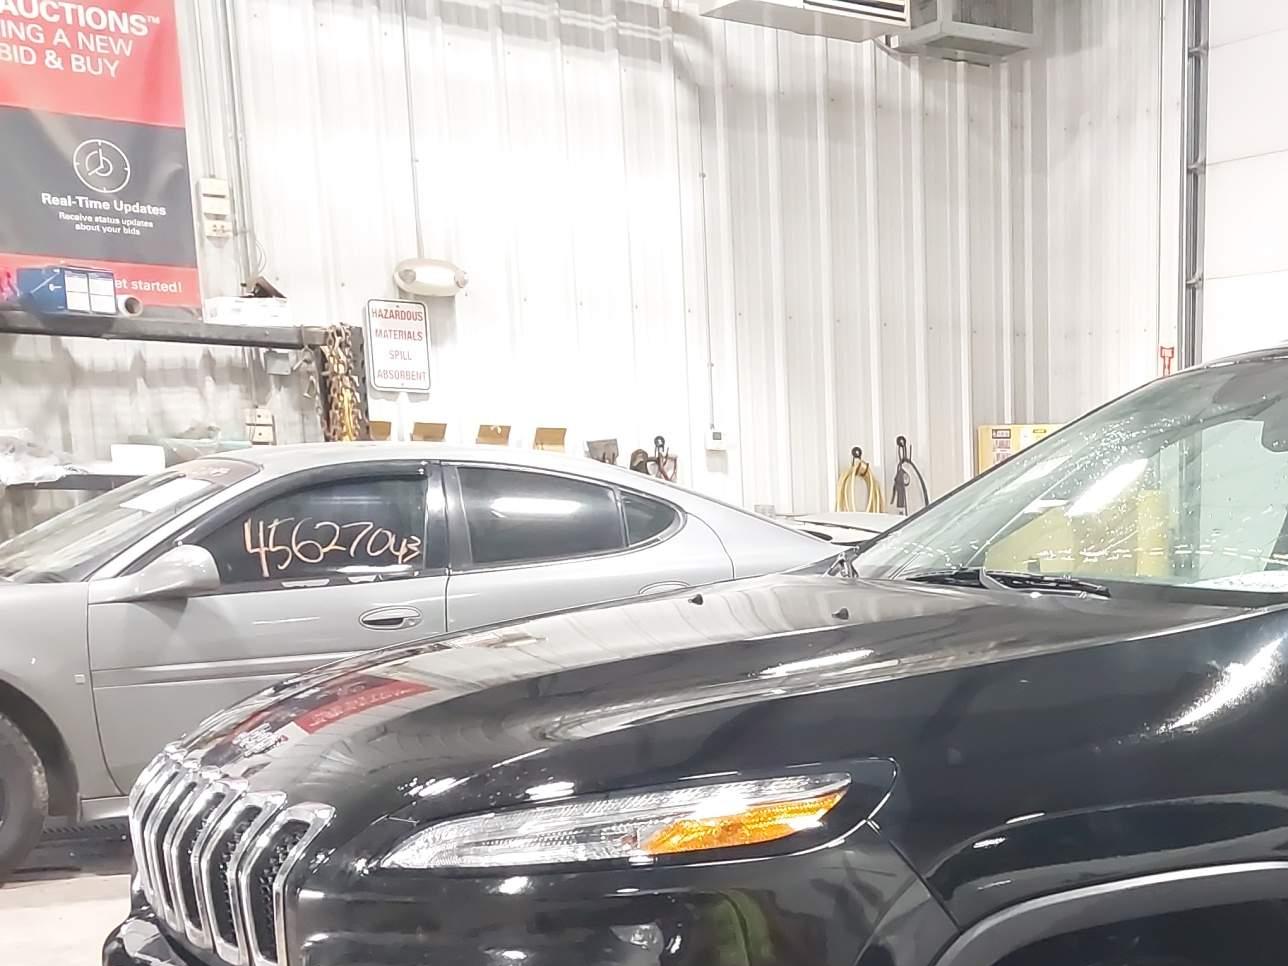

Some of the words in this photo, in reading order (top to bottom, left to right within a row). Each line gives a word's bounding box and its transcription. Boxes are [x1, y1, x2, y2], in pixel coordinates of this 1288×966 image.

[53, 28, 71, 48] A
[77, 31, 133, 56] NEW
[0, 42, 37, 65] BID
[44, 48, 64, 70] &
[70, 53, 120, 78] BUY
[41, 192, 110, 210] Real-Time
[113, 199, 167, 216] Updates
[58, 211, 93, 222] Receive
[94, 214, 120, 225] status
[121, 217, 154, 228] updates
[74, 222, 101, 232] about
[101, 225, 121, 234] your
[122, 225, 141, 235] bids
[114, 278, 129, 289] et
[130, 279, 183, 294] started!
[371, 307, 424, 322] HAZARDOUS
[374, 328, 423, 342] MATERIALS
[388, 350, 413, 361] SPILL
[376, 368, 427, 382] ABSORBENT
[243, 516, 422, 578] 45627043
